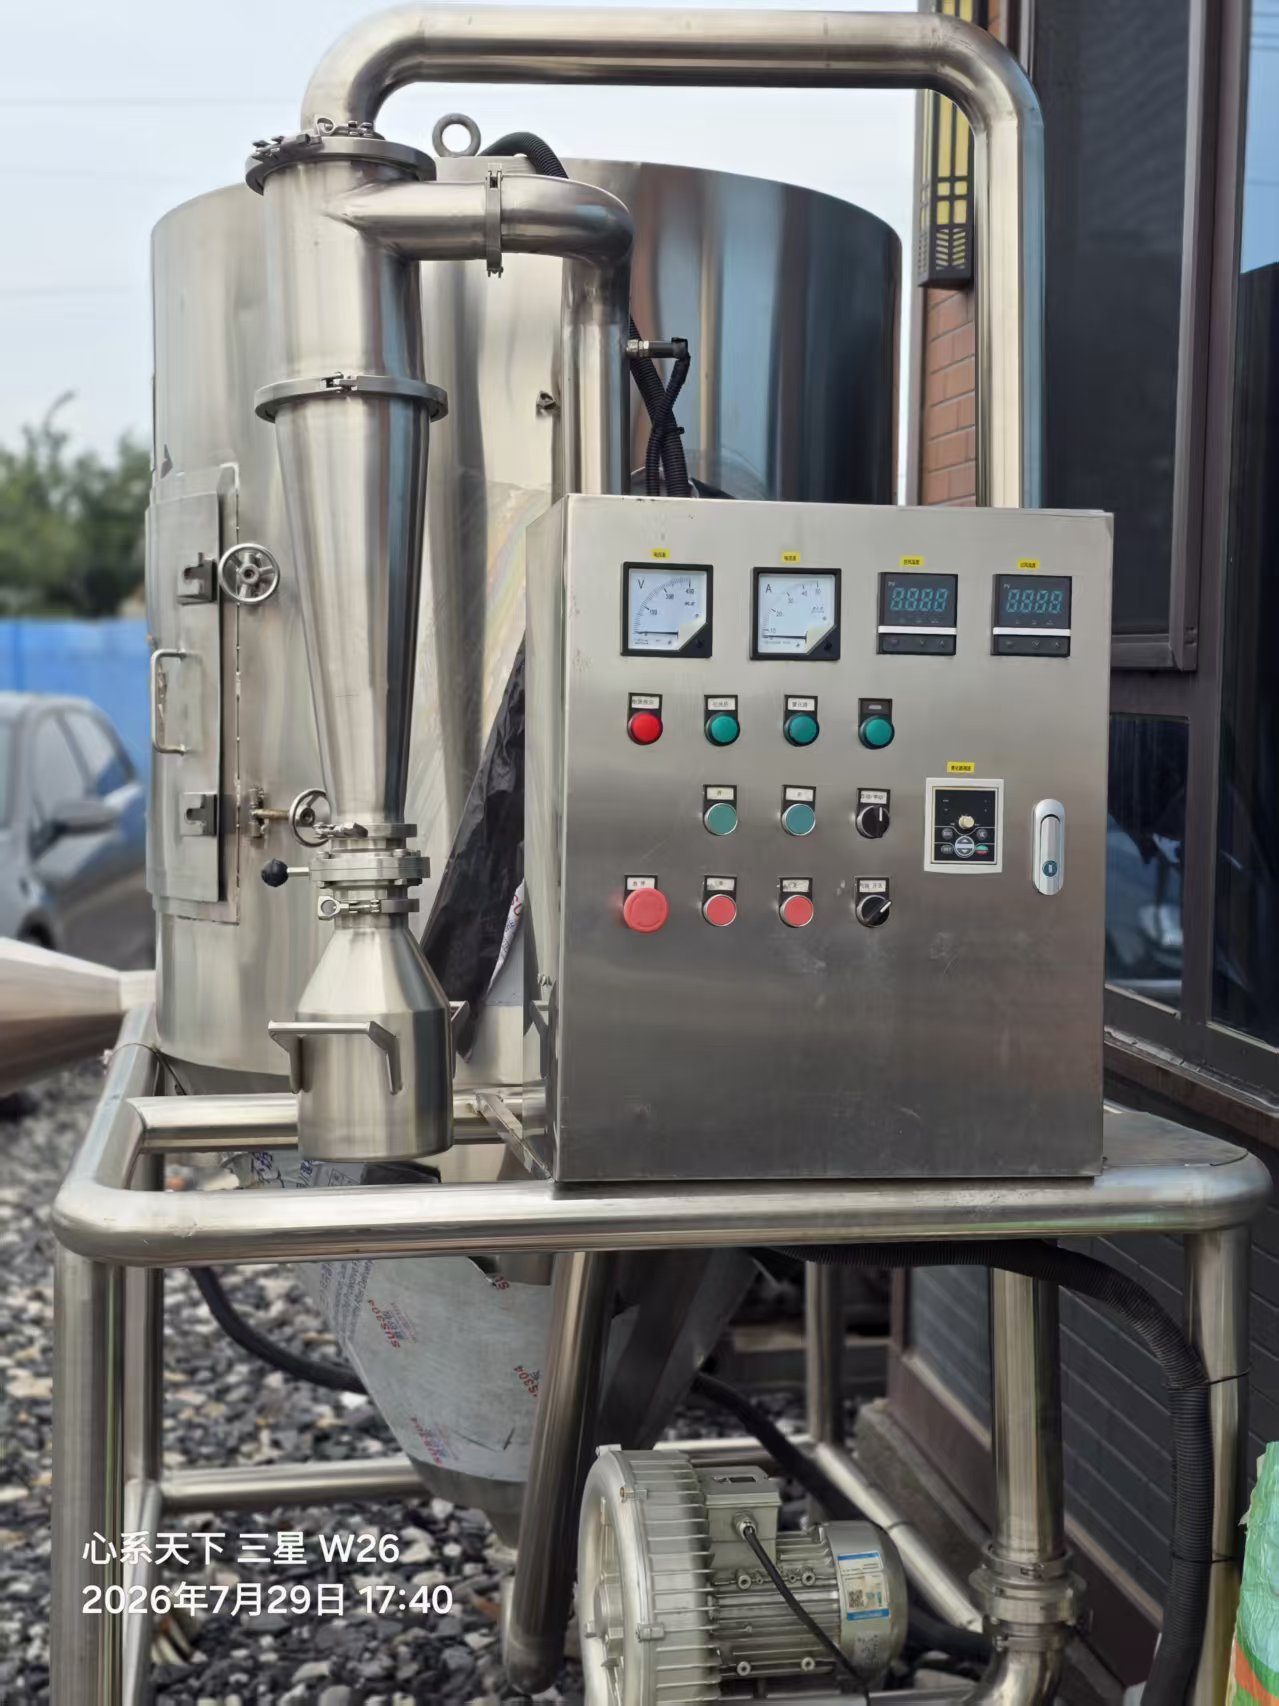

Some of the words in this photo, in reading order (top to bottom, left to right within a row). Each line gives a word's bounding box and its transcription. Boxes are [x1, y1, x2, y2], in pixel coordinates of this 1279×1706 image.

[637, 579, 645, 589] V
[765, 584, 772, 593] A
[513, 1364, 538, 1397] S304
